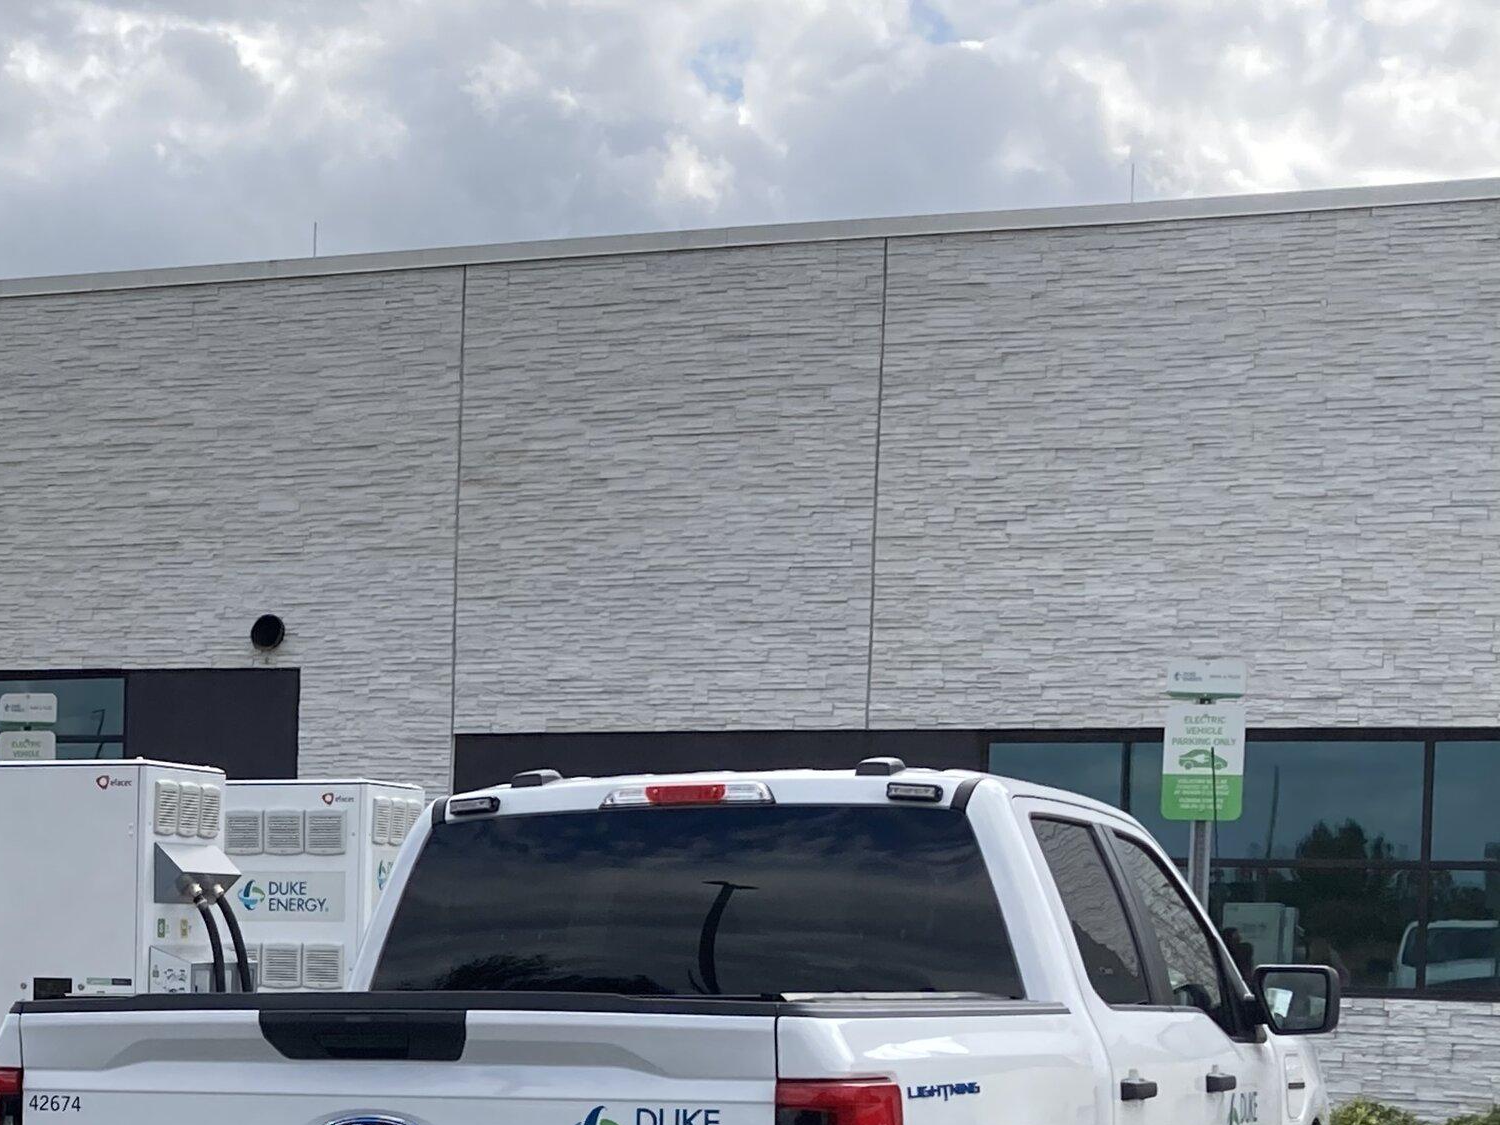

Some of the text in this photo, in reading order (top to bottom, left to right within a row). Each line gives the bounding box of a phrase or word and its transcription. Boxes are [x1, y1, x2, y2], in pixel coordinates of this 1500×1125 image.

[1184, 715, 1226, 724] ELECTRIC
[1186, 727, 1223, 735] VEHICLE
[1171, 737, 1236, 746] PARKING ONLY
[13, 750, 41, 758] VEHICLE
[268, 881, 308, 896] DUKE
[267, 897, 327, 912] ENERGY
[907, 1081, 981, 1102] LIGHTNING
[29, 1094, 81, 1112] 42674
[1239, 1091, 1258, 1123] DUKE
